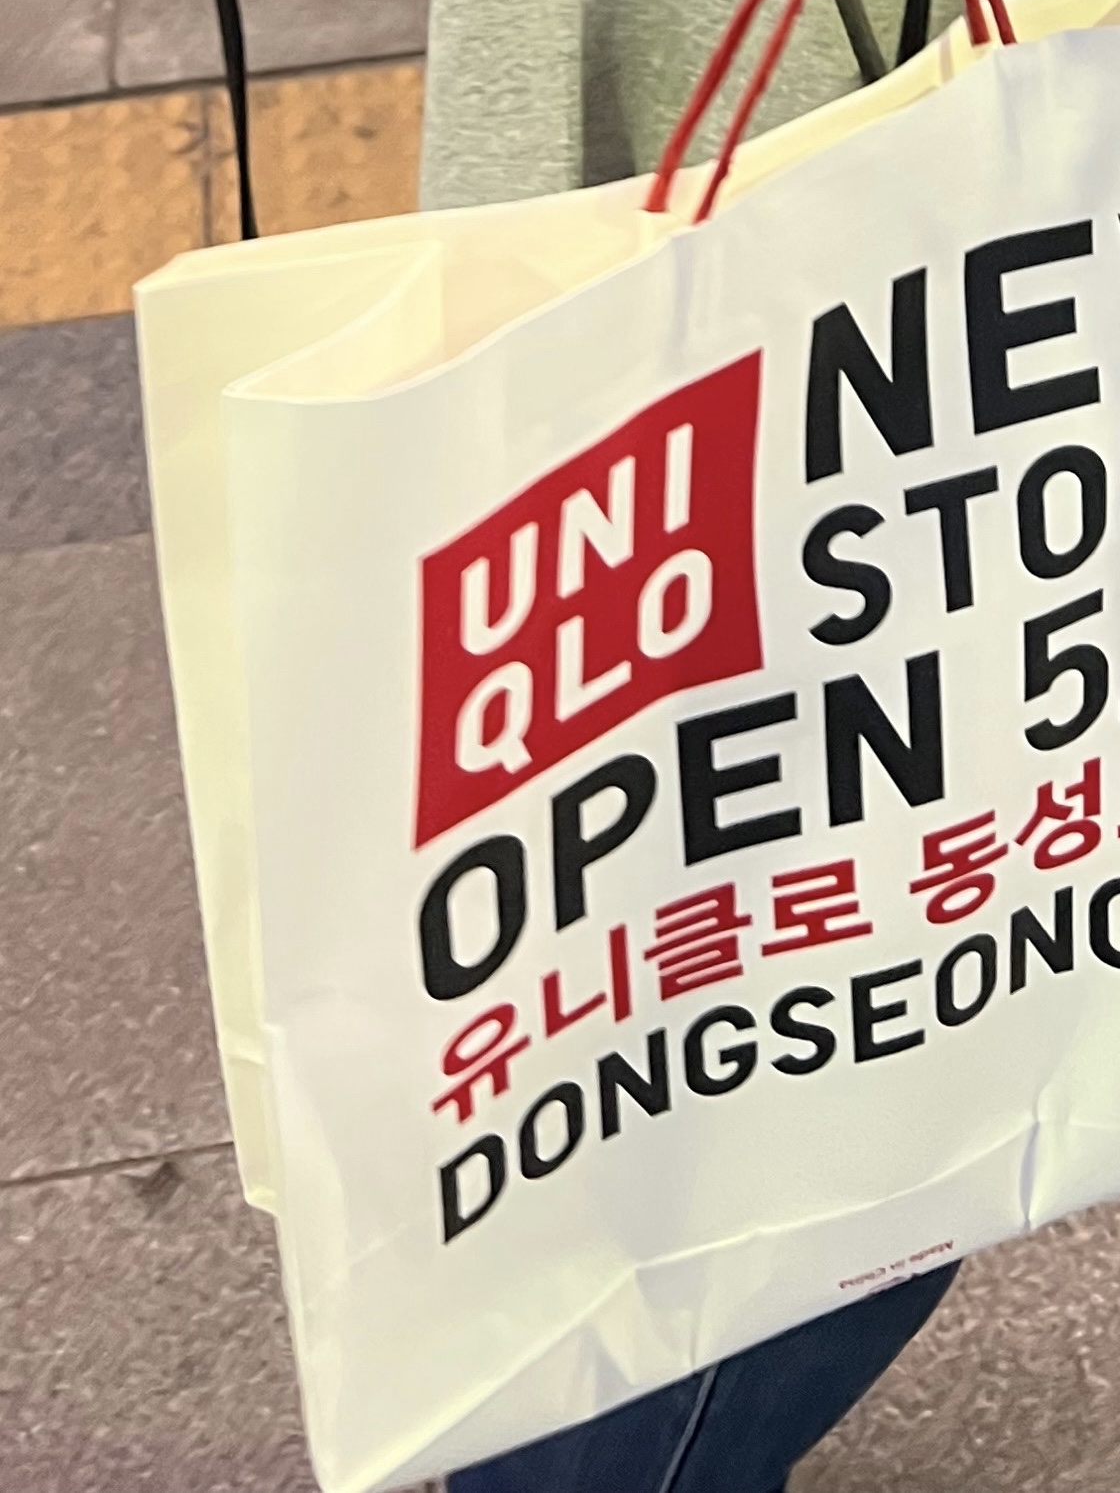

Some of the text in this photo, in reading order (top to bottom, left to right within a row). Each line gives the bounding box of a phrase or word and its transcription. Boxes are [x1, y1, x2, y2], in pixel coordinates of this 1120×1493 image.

[454, 548, 714, 775] QLO
[459, 422, 694, 657] UNI
[418, 649, 946, 1002] OPEN
[432, 859, 874, 1124] 유니클로
